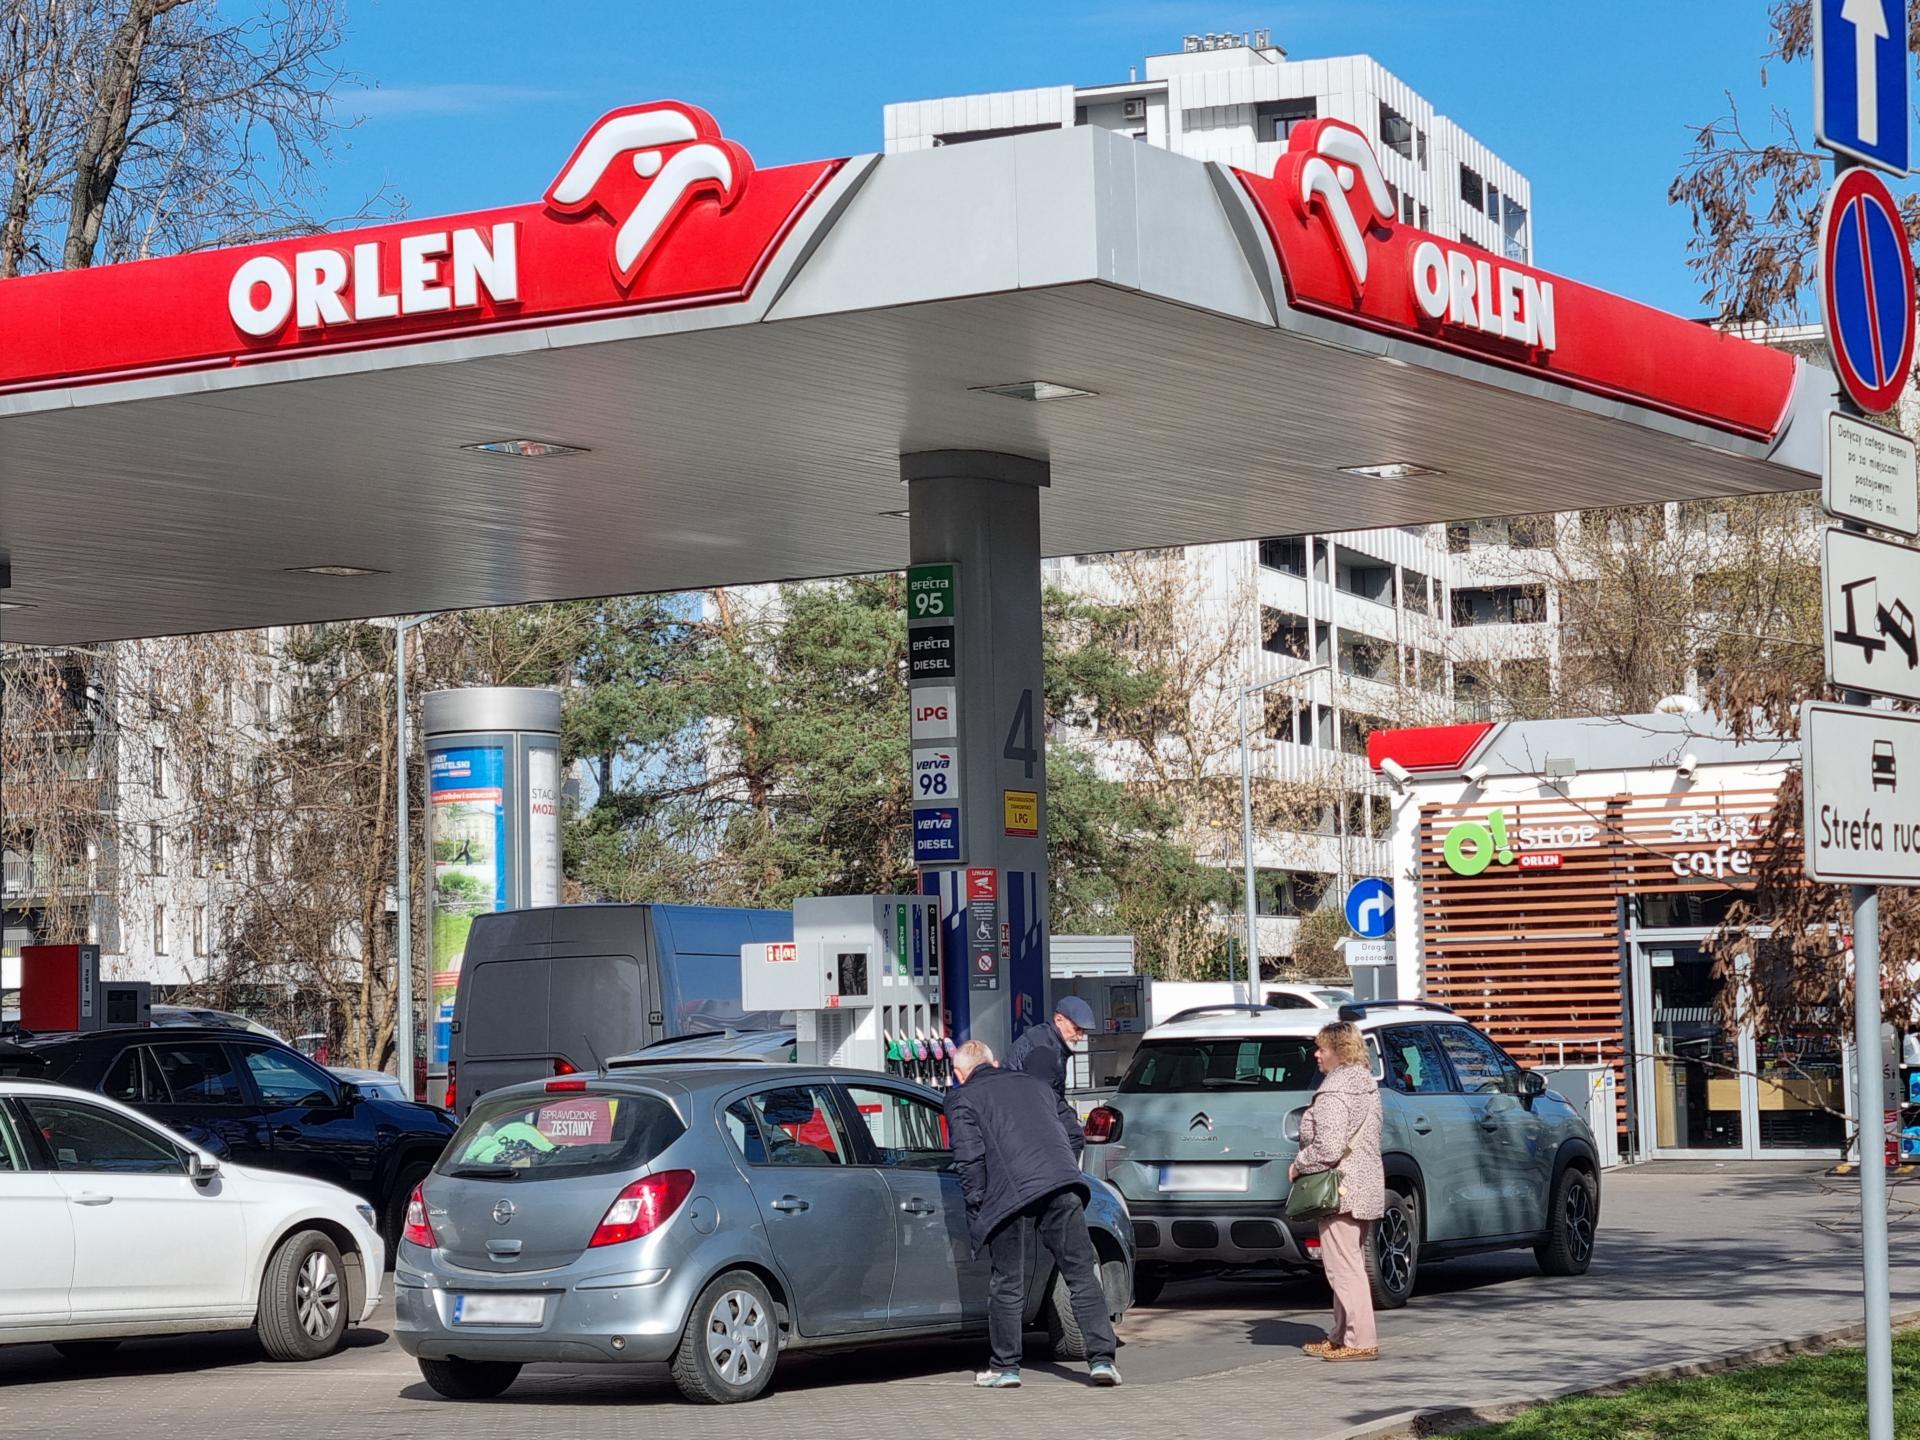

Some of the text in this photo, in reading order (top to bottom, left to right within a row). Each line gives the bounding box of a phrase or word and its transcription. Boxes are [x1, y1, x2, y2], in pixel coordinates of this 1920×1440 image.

[228, 223, 518, 337] ORLEN
[1413, 241, 1556, 351] ORLEN
[1838, 424, 1861, 447] Dotyczy
[1888, 442, 1907, 459] terenu
[1848, 452, 1898, 475] po za miejscami
[1855, 475, 1892, 495] postojowymi
[1849, 493, 1873, 512] powyżej
[1876, 498, 1883, 512] 15
[911, 579, 949, 591] efecta
[915, 593, 944, 615] 95
[912, 639, 950, 651] efecta
[914, 659, 950, 670] DIESEL
[916, 706, 948, 721] LPG
[1003, 689, 1038, 779] 4
[916, 759, 951, 770] verva
[919, 772, 948, 795] 98
[917, 818, 952, 829] verva
[1014, 812, 1028, 824] LPG
[1820, 804, 1883, 851] Strefa
[1671, 812, 1751, 847] stop
[917, 839, 954, 850] DIESEL
[1443, 808, 1597, 876] O! SHOP
[1521, 855, 1559, 866] ORLEN
[1672, 846, 1752, 879] cafe
[1361, 943, 1387, 952] Droga
[541, 1110, 598, 1120] SPRAWDZONE
[551, 1121, 593, 1136] ZESTAWY
